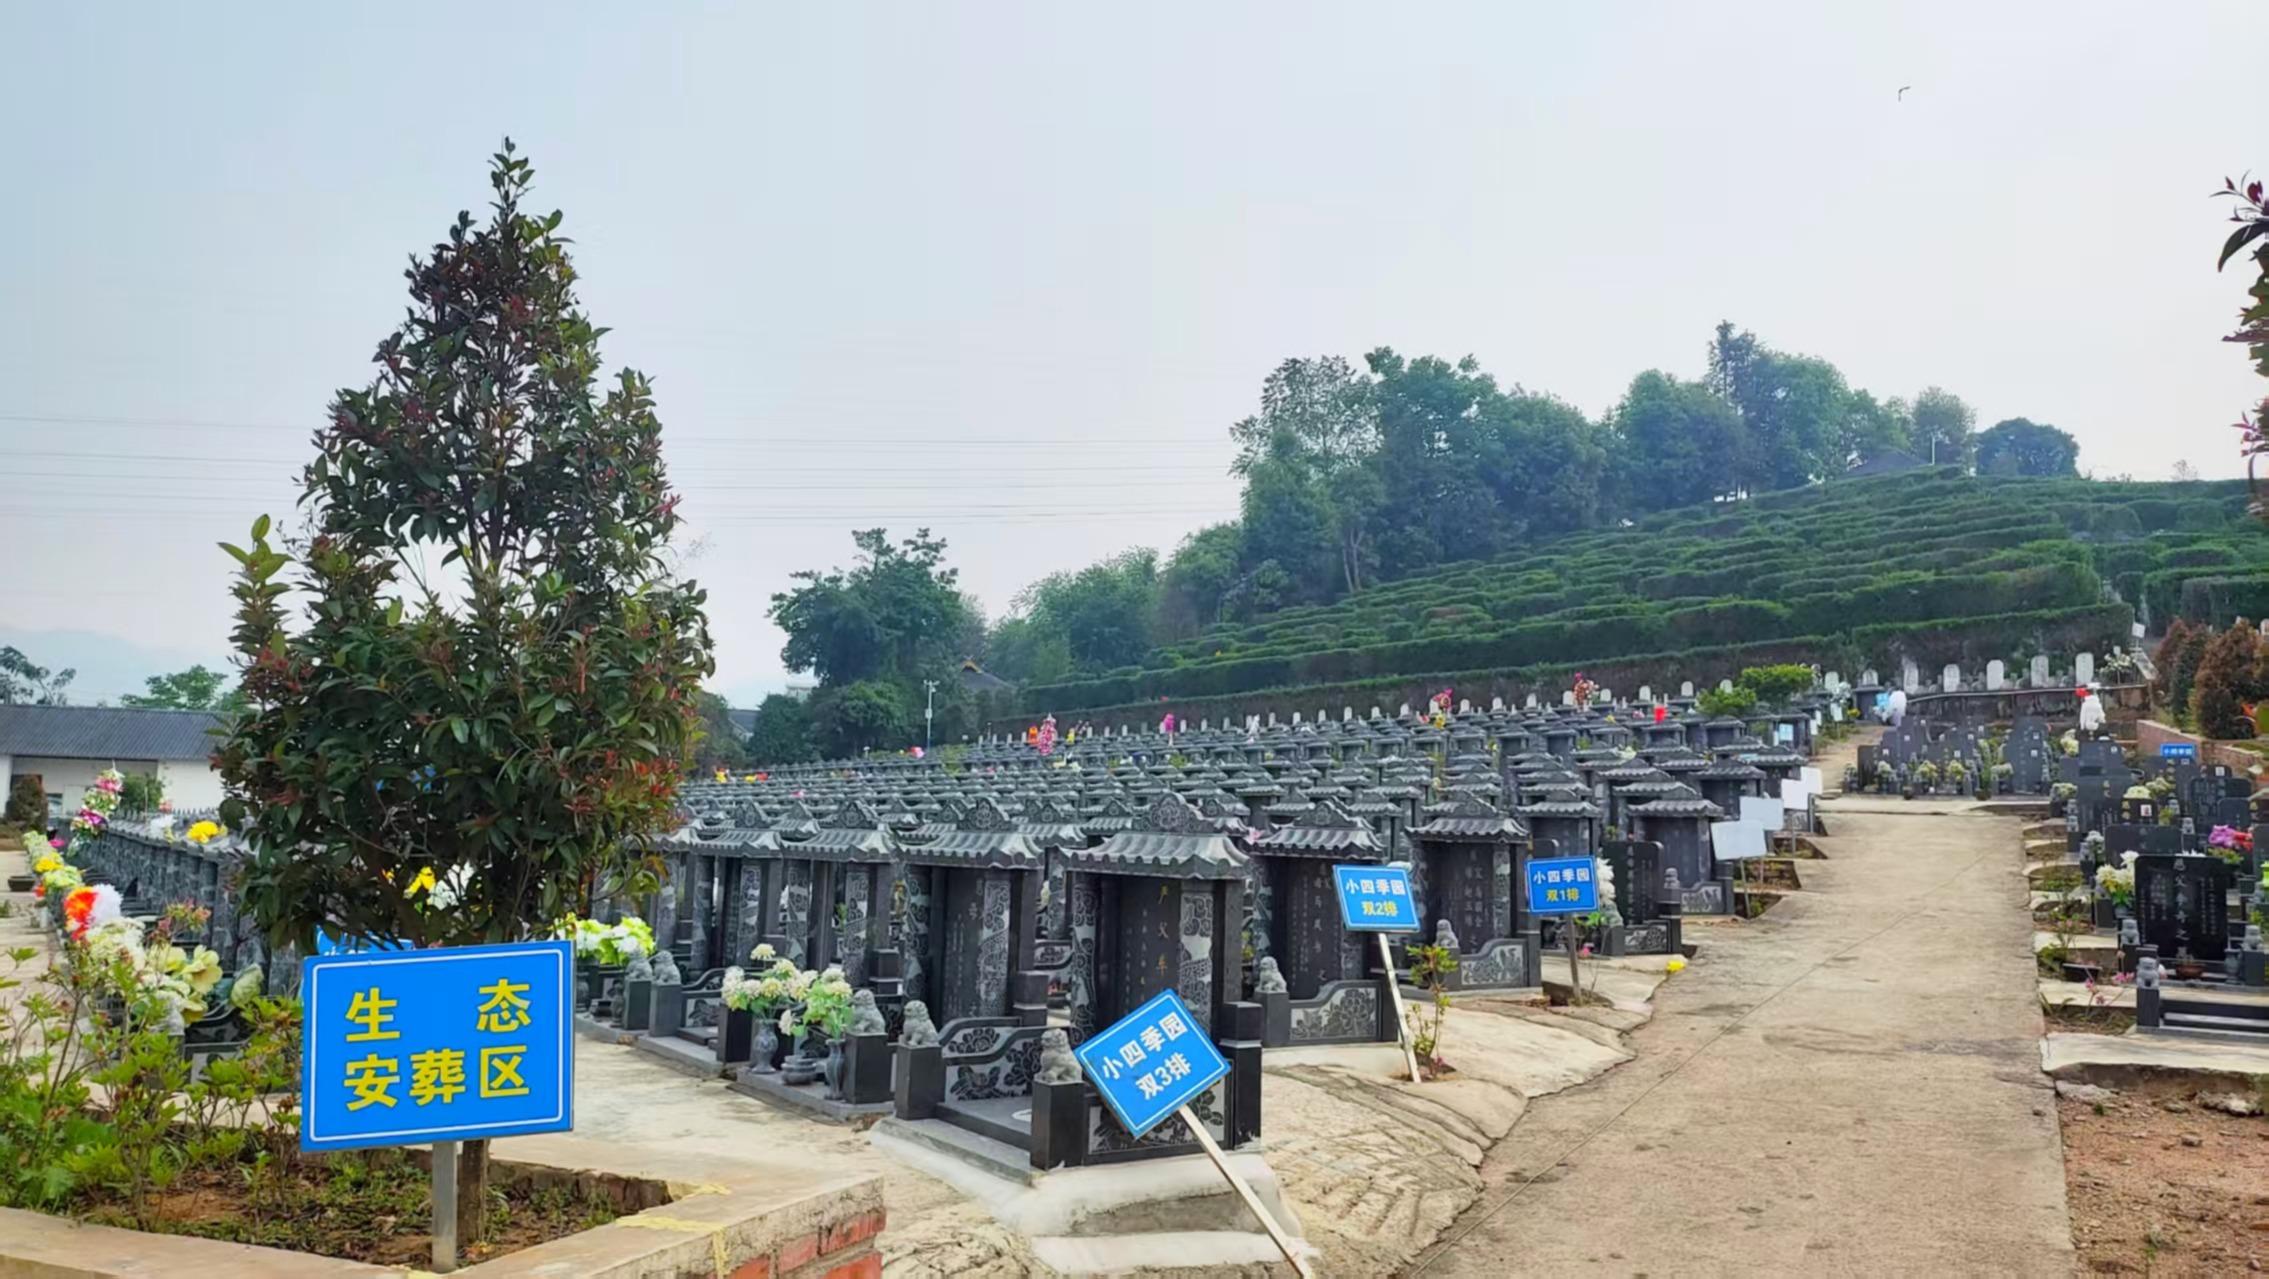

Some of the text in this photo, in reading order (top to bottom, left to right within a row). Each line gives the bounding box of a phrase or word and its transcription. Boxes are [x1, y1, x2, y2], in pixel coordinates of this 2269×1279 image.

[1346, 878, 1406, 895] 小四季园
[1534, 867, 1590, 884] 小四季园
[1362, 900, 1398, 916] 双2排
[1546, 887, 1579, 902] 双1排
[345, 979, 531, 1041] 生态
[1102, 1011, 1188, 1079] 小四季园
[344, 1046, 530, 1111] 安葬区
[1135, 1052, 1191, 1099] 双3排
